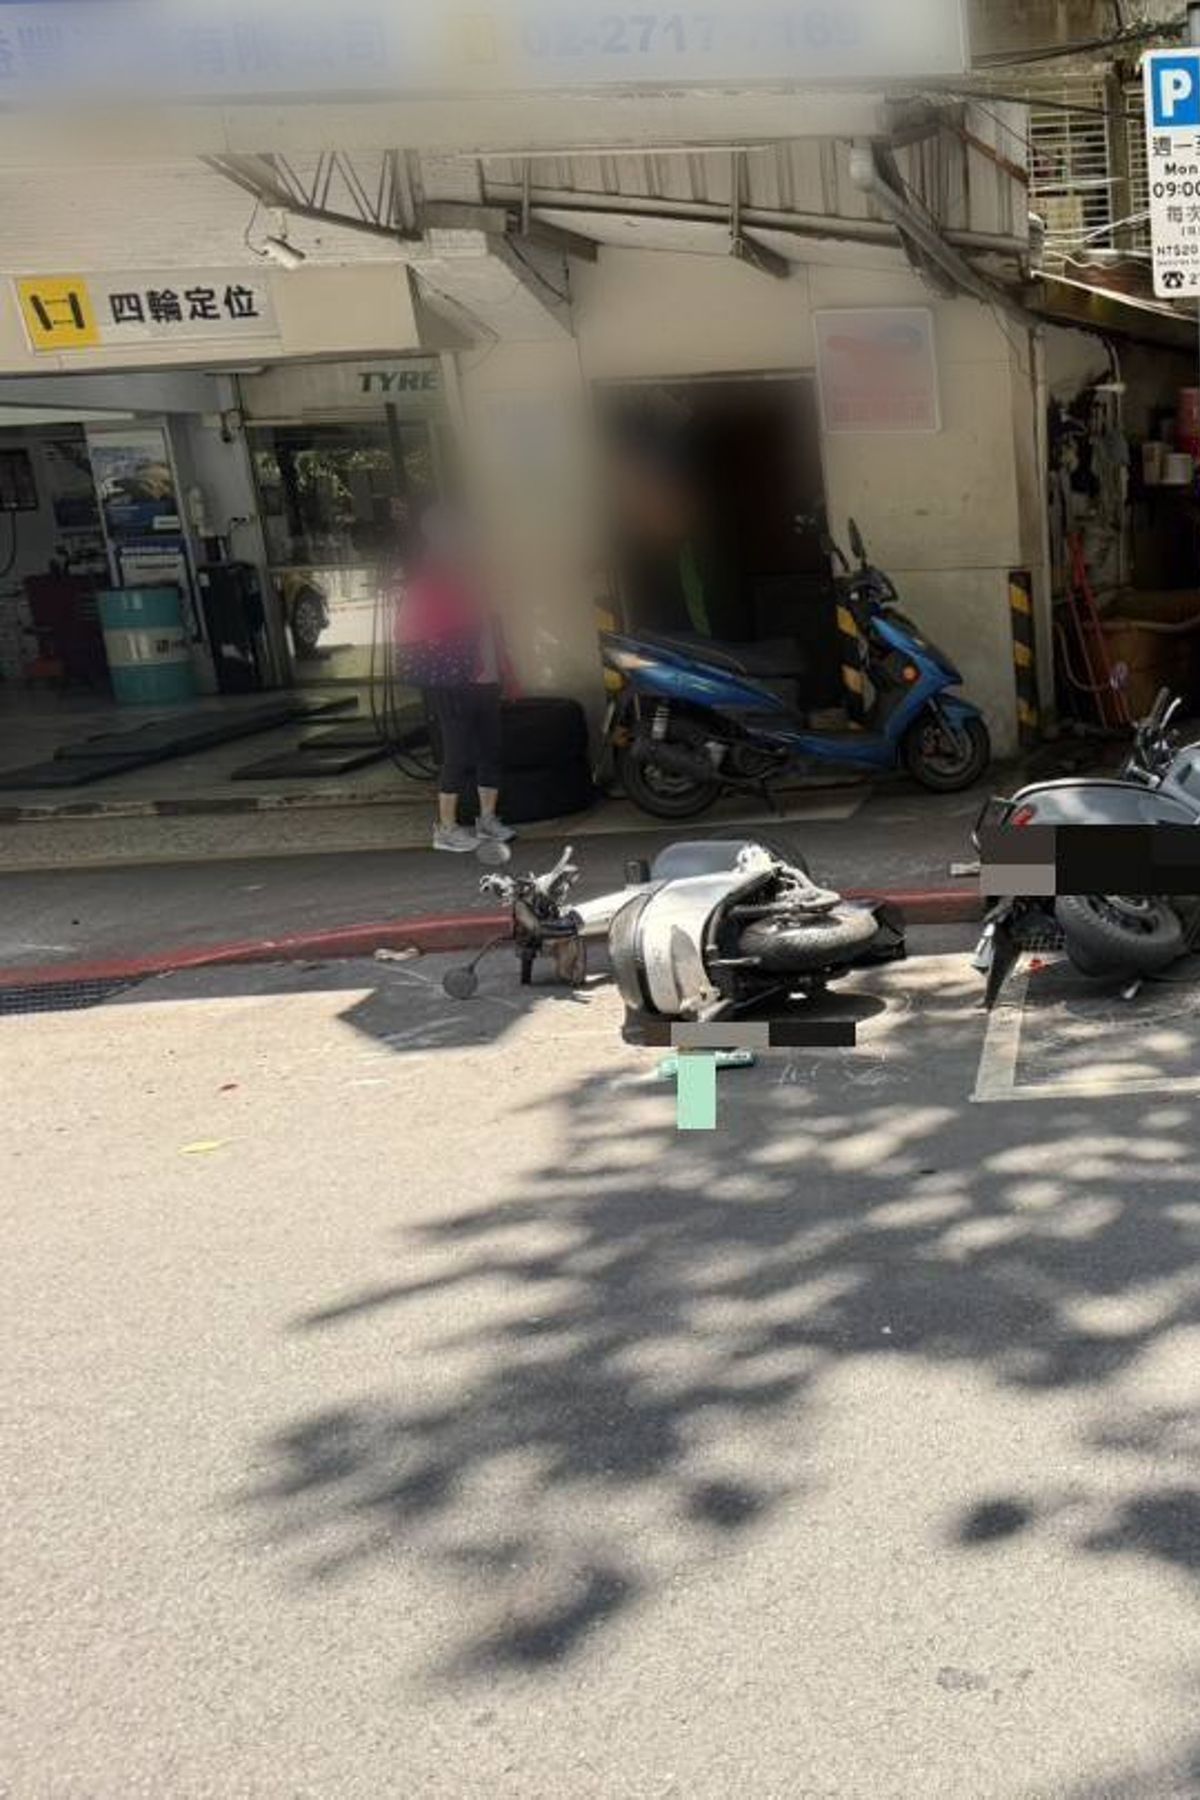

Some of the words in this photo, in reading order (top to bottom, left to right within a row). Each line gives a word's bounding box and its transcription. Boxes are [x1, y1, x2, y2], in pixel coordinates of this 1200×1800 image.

[1159, 68, 1192, 118] P
[108, 284, 260, 325] 四輪定位
[358, 370, 439, 393] TYRE
